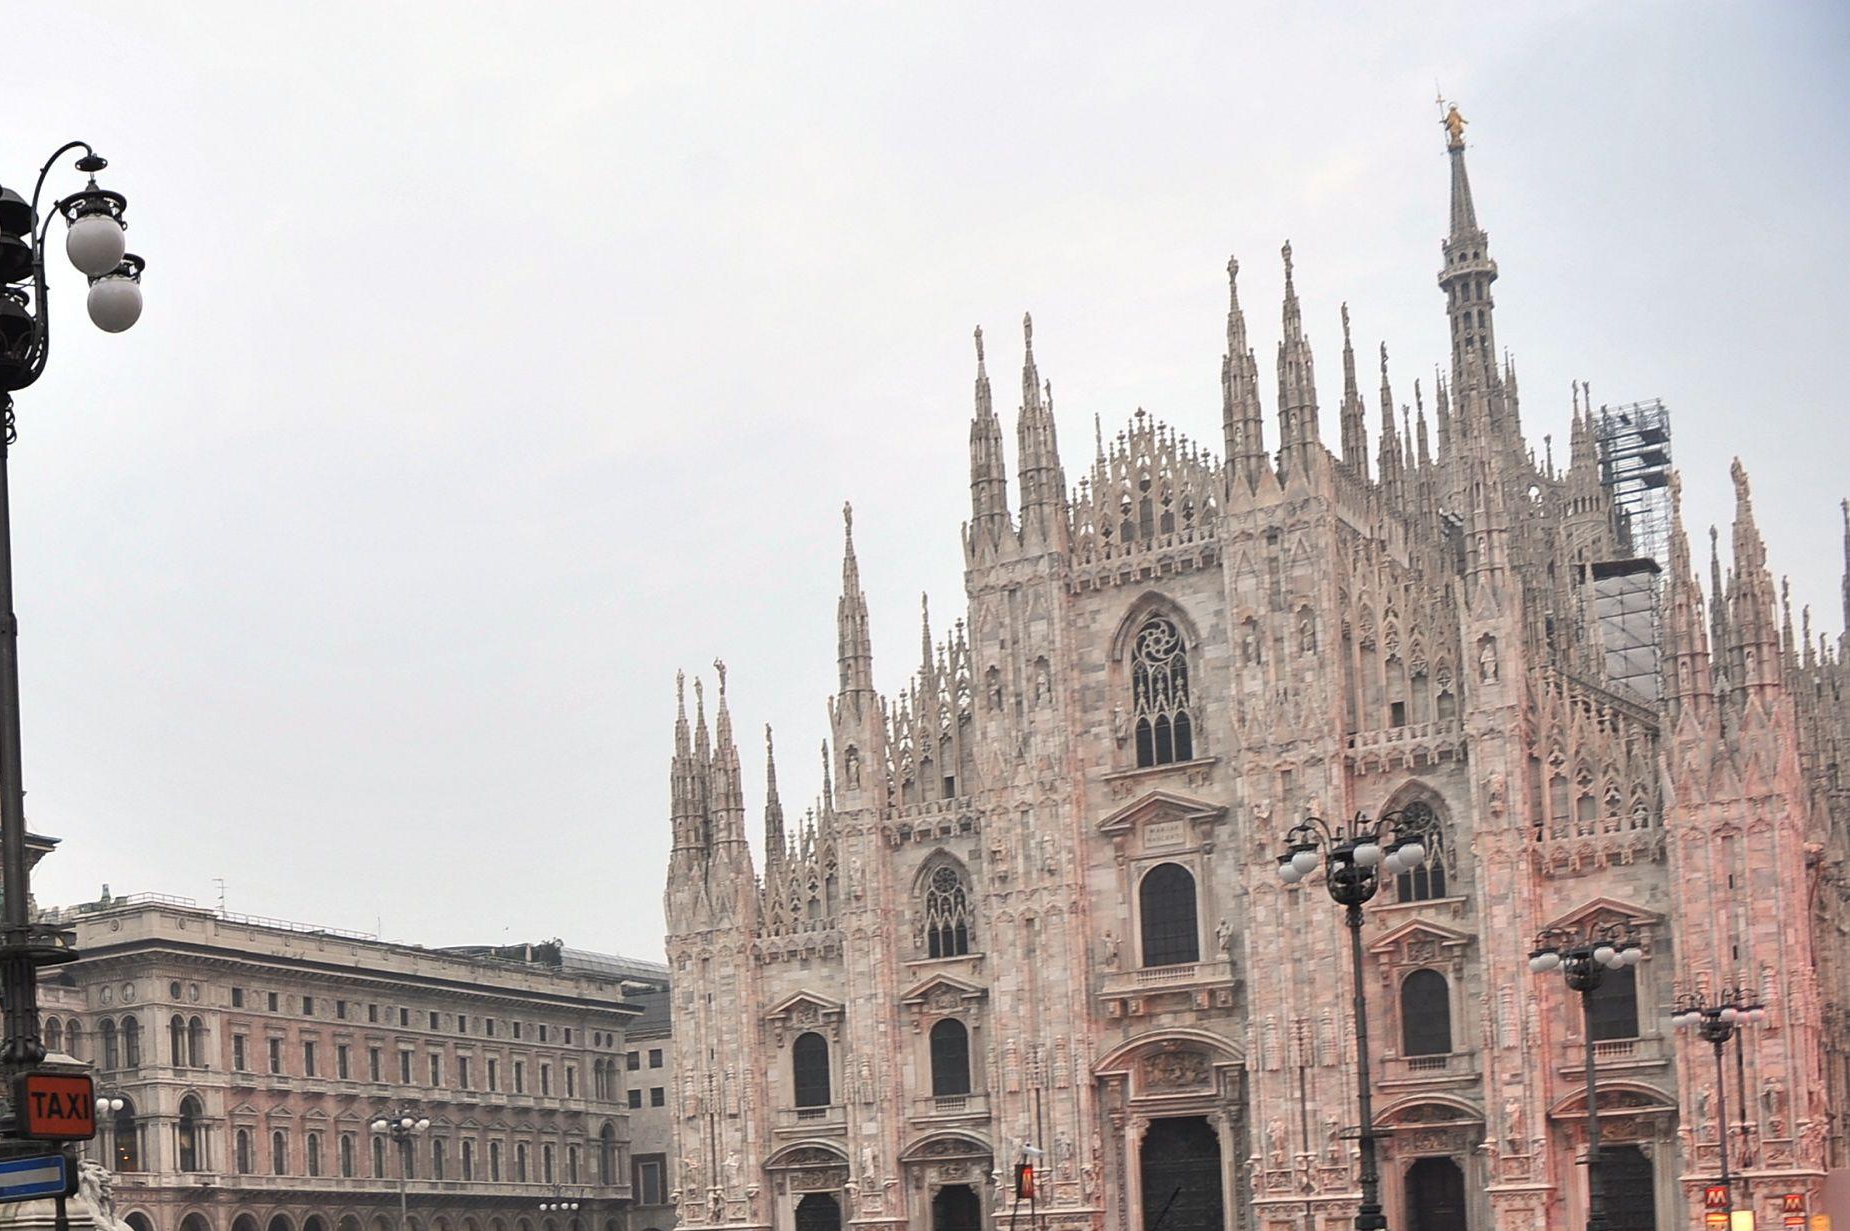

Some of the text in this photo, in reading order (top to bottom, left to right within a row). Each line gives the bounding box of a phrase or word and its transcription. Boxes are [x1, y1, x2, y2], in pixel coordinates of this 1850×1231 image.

[31, 1092, 89, 1120] TAXI
[1707, 1190, 1726, 1204] M
[1785, 1198, 1800, 1209] M
